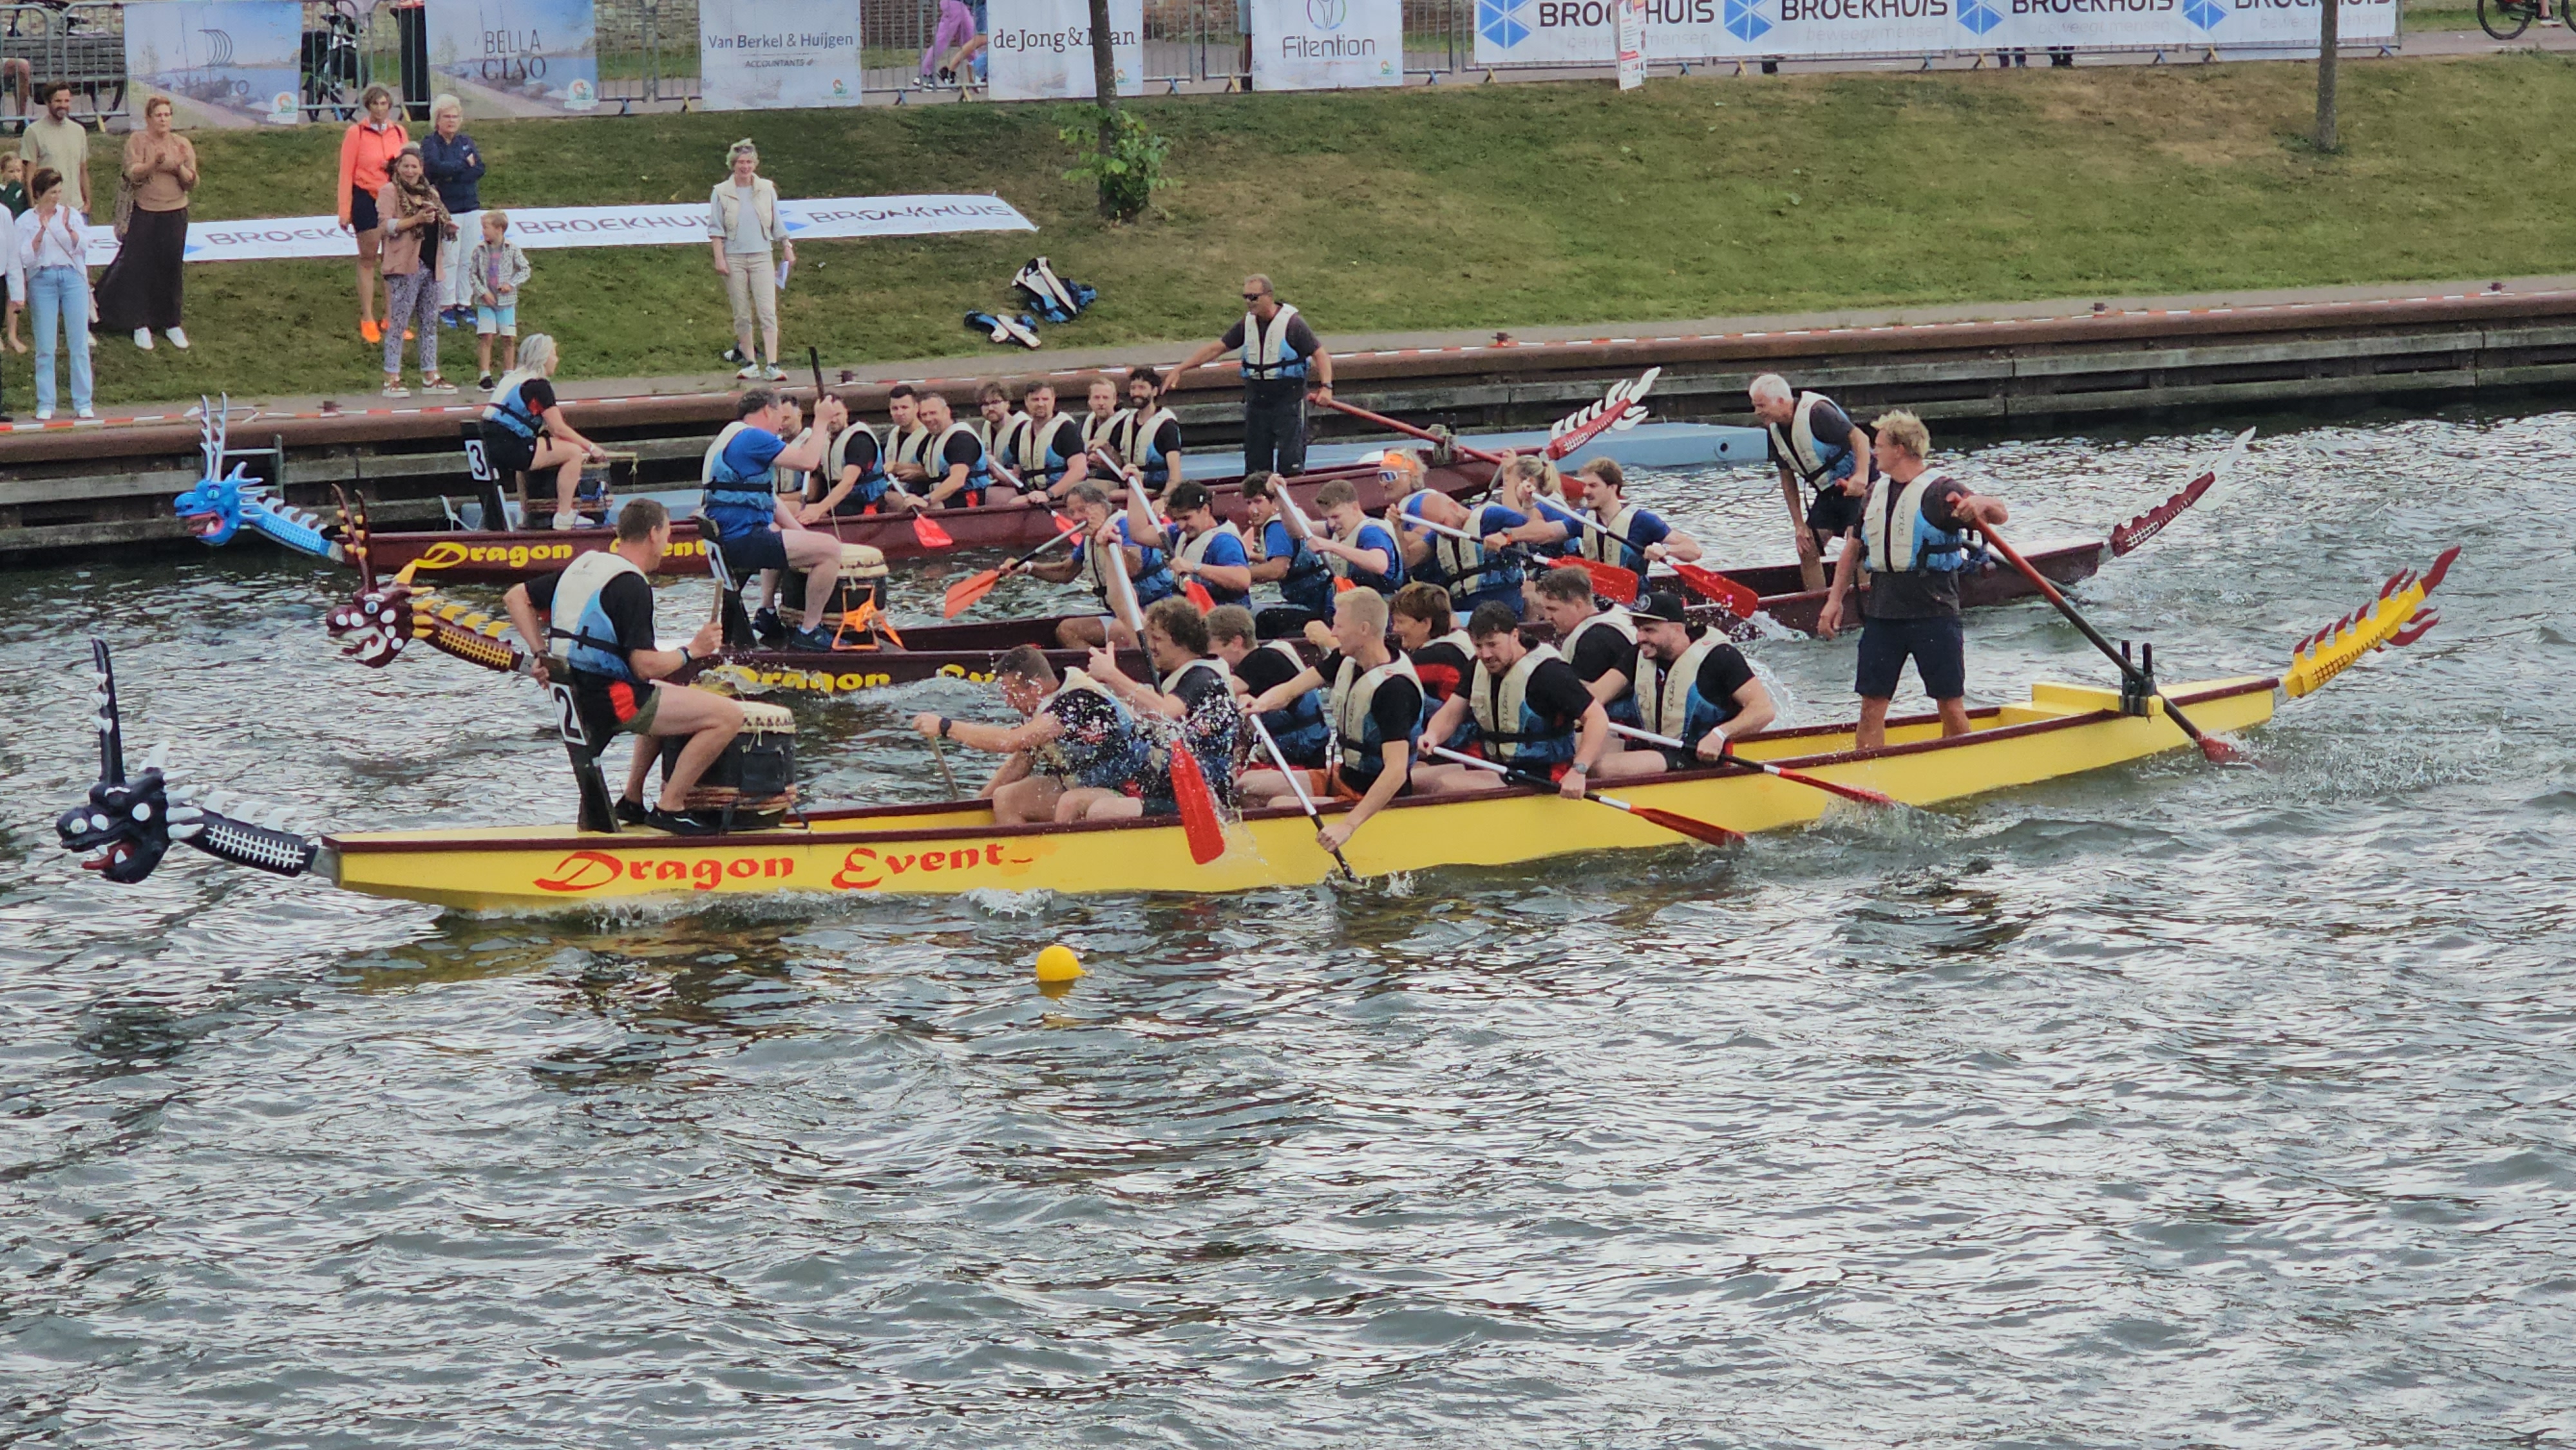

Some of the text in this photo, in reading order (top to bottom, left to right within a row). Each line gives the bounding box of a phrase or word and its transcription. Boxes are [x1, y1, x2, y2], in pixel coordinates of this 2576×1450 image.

[1539, 0, 1714, 27] BROHUIS
[1782, 0, 1947, 21] BROEKHUIS
[485, 29, 541, 53] BELLA
[708, 32, 853, 50] Van Berkel & Huijgen
[1282, 33, 1376, 59] Fitention
[482, 55, 546, 80] CIAO
[744, 59, 805, 68] ACCOUNTANTS
[205, 227, 356, 245] BROEK
[515, 215, 711, 234] BROEKHUI
[469, 444, 487, 477] 3
[415, 541, 573, 569] Dragon
[710, 546, 728, 585] 1
[554, 686, 583, 740] 2
[532, 842, 1006, 890] Dragon Event
